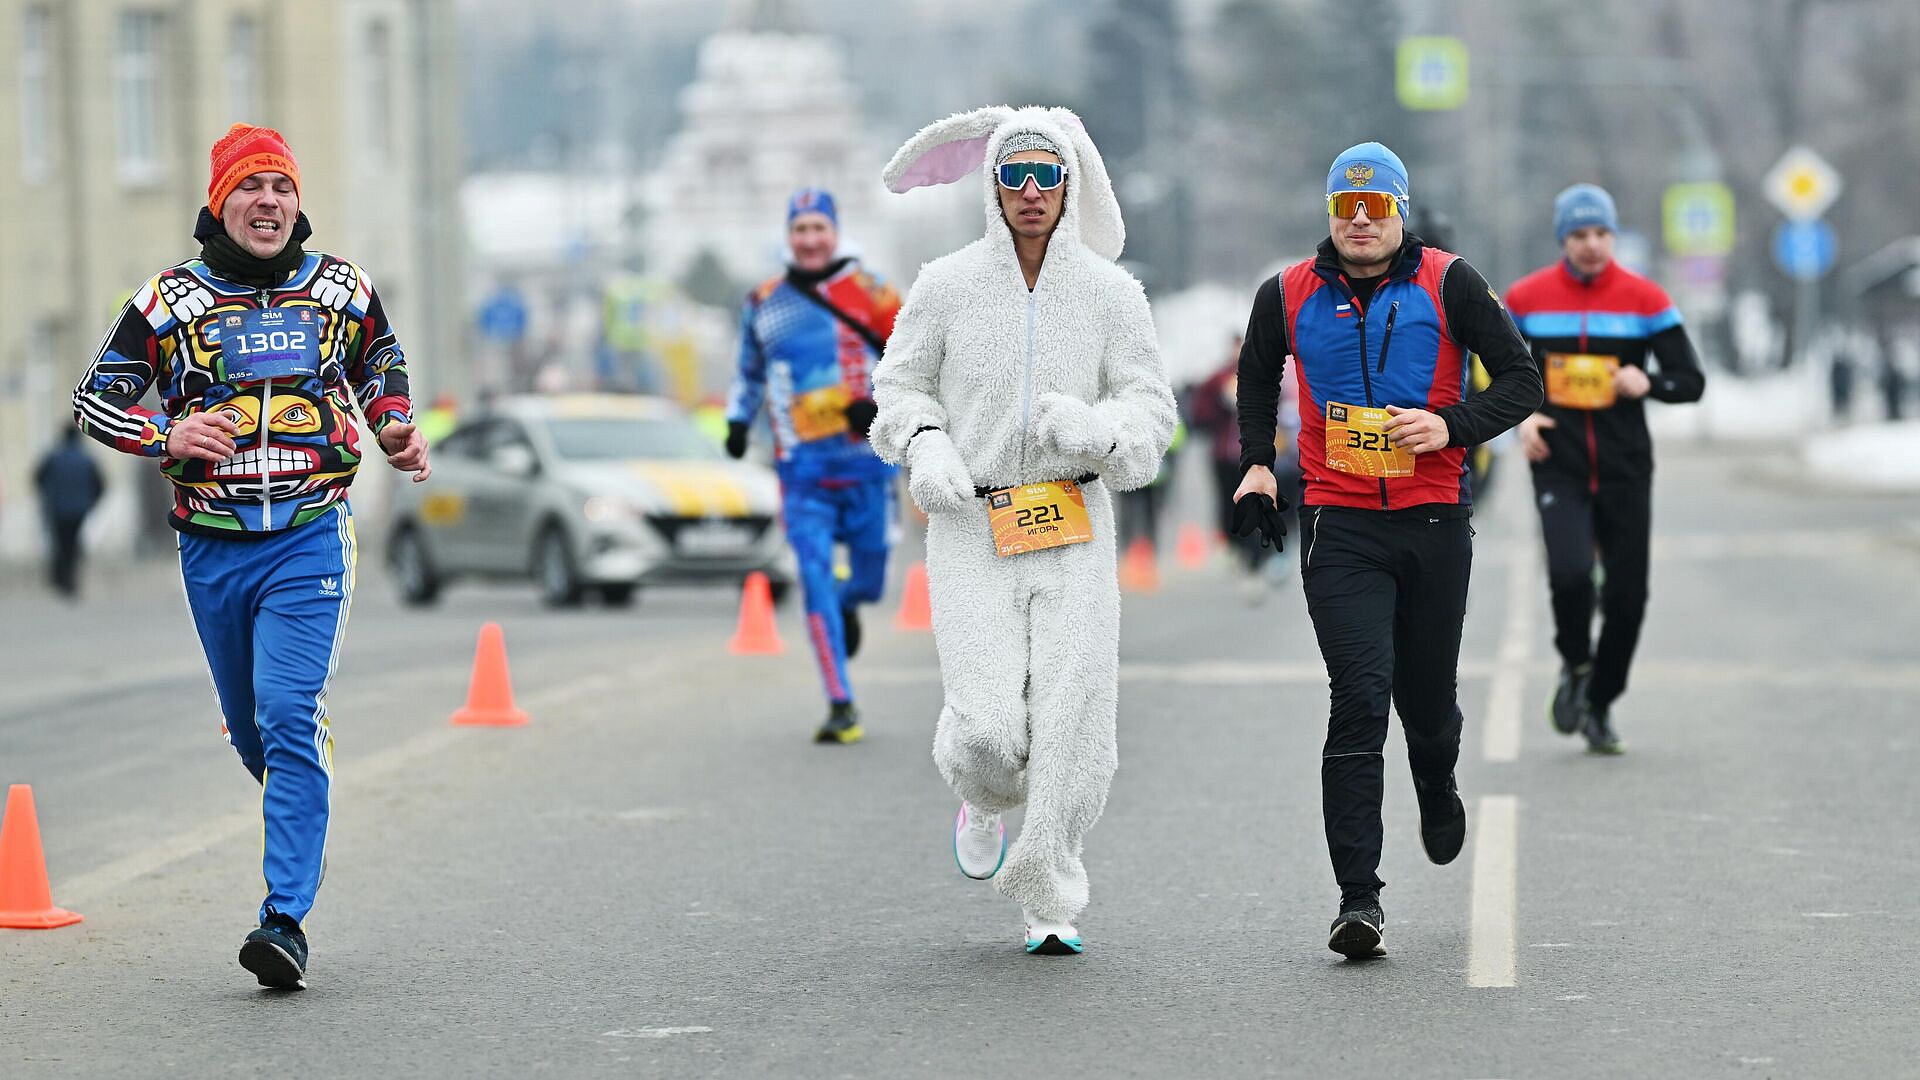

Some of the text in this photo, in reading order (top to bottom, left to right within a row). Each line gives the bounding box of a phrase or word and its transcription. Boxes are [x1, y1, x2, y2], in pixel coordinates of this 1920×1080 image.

[237, 331, 306, 354] 1302
[1347, 429, 1392, 452] 321
[1016, 503, 1064, 527] 221
[1027, 525, 1059, 535] ИГОРЬ
